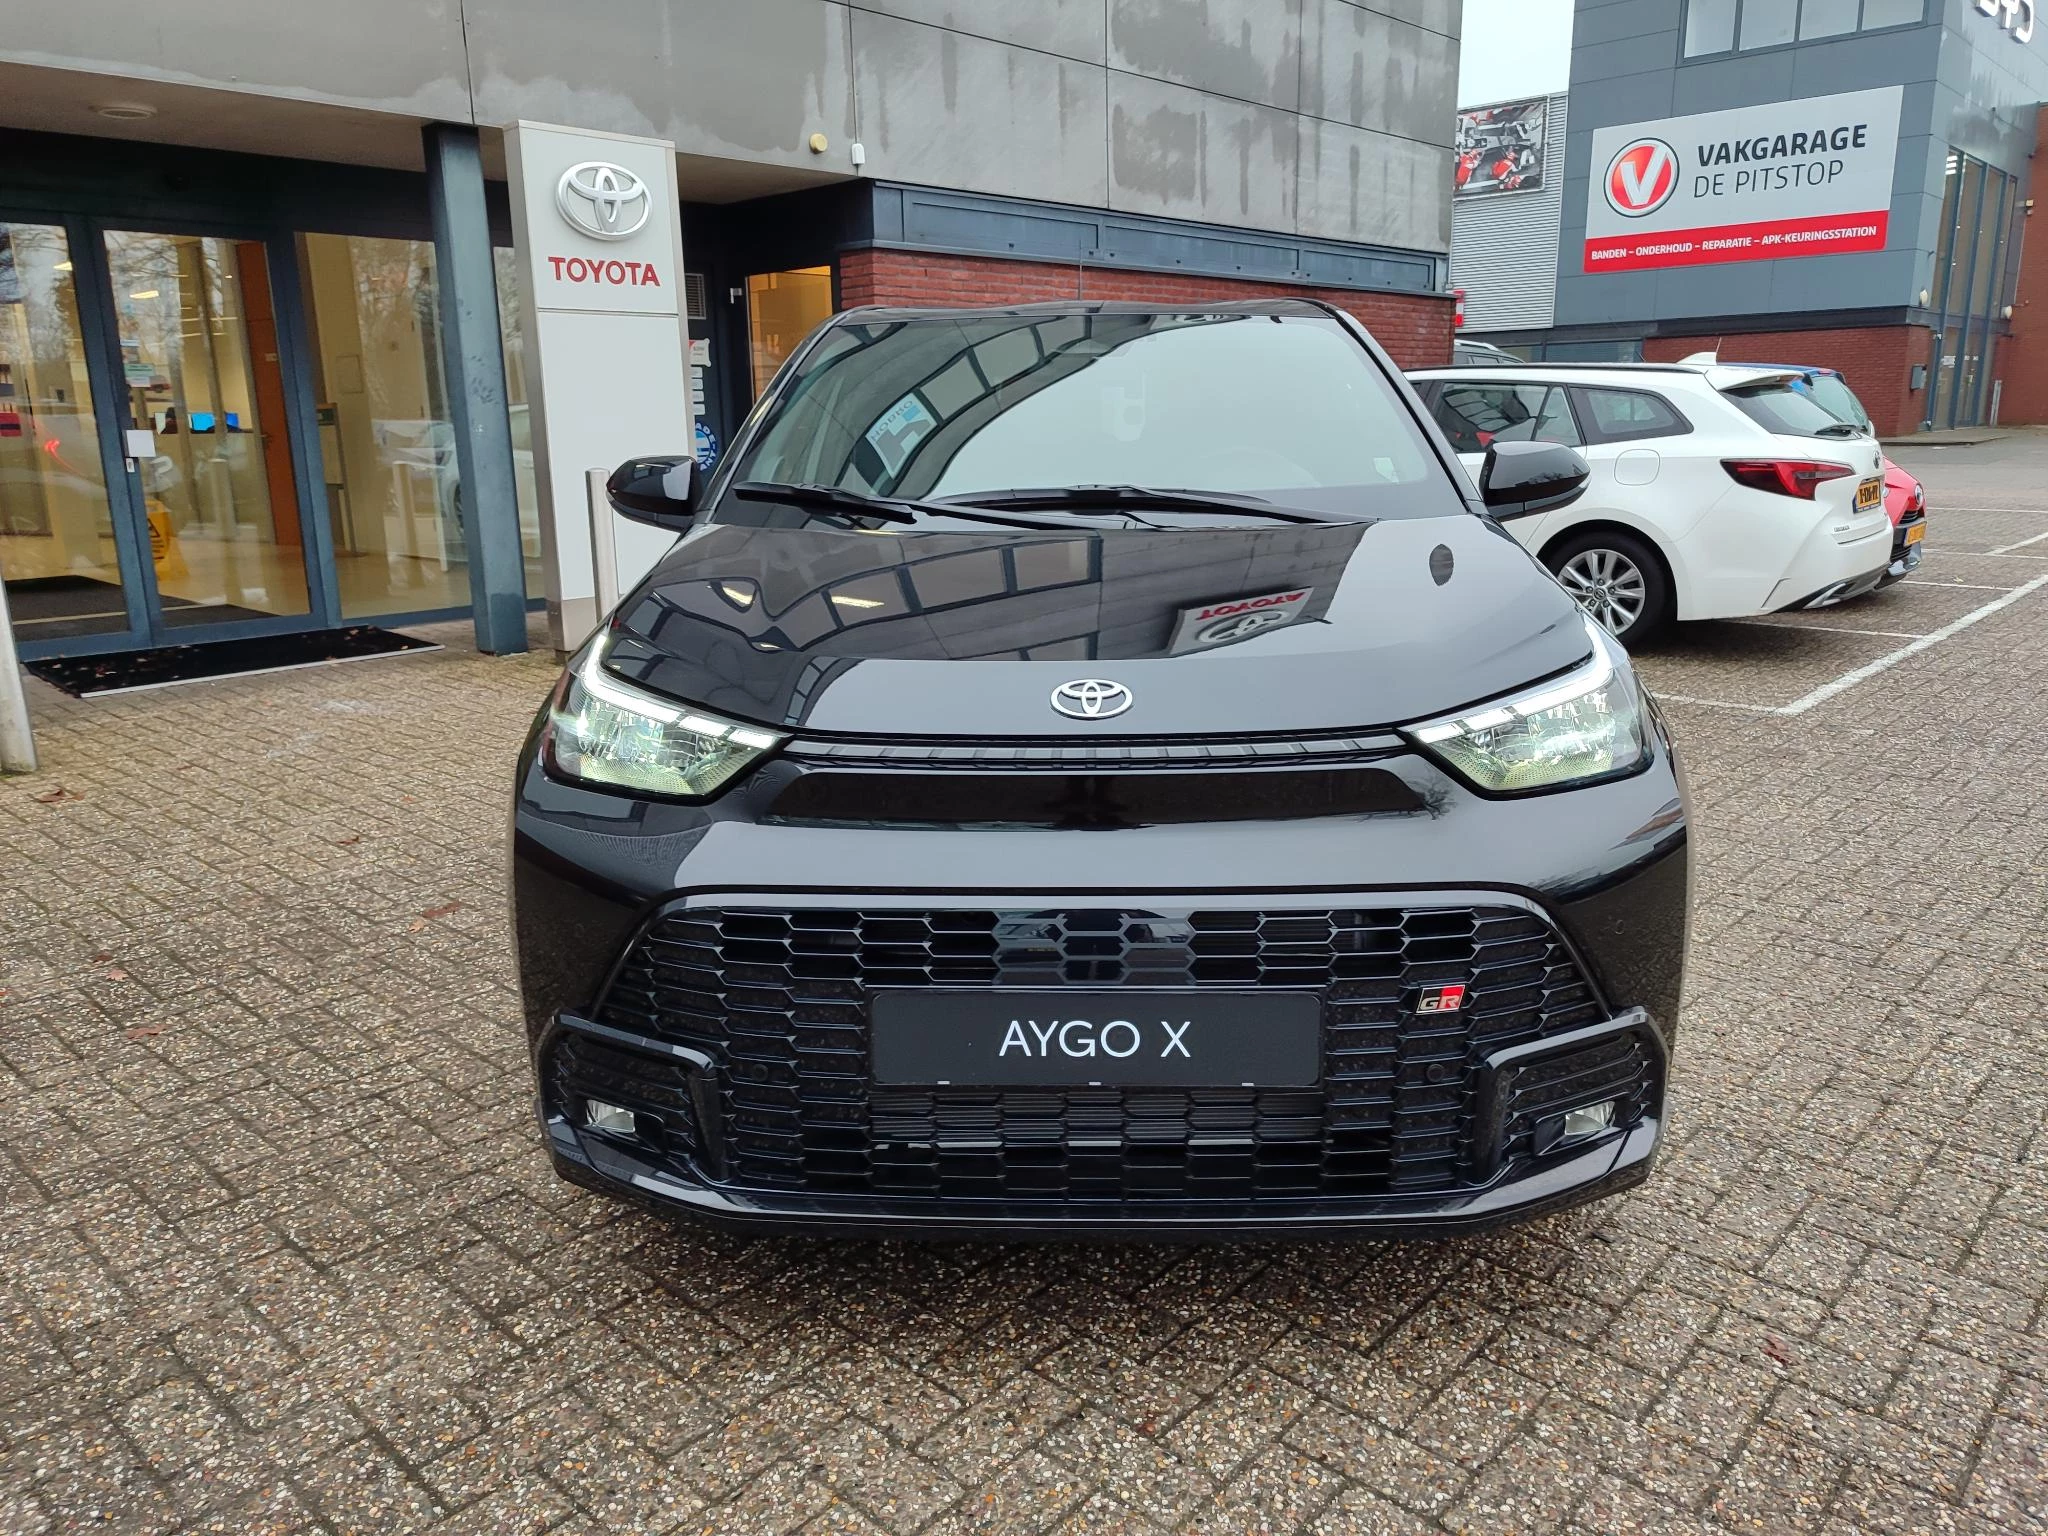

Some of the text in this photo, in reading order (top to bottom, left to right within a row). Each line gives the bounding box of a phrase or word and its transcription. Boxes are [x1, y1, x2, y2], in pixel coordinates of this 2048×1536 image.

[1697, 123, 1868, 167] VAKGARAGE
[1693, 159, 1844, 198] DE PITSTOP
[1591, 248, 1627, 261] BANDEN
[1635, 242, 1693, 257] ONDERHOUD
[1702, 236, 1753, 251] REPARATIE
[1761, 226, 1877, 246] APK-KEURINGSSTATION
[548, 256, 661, 287] TOYOTA
[1419, 995, 1460, 1011] GR
[998, 1020, 1191, 1058] AYGO X
